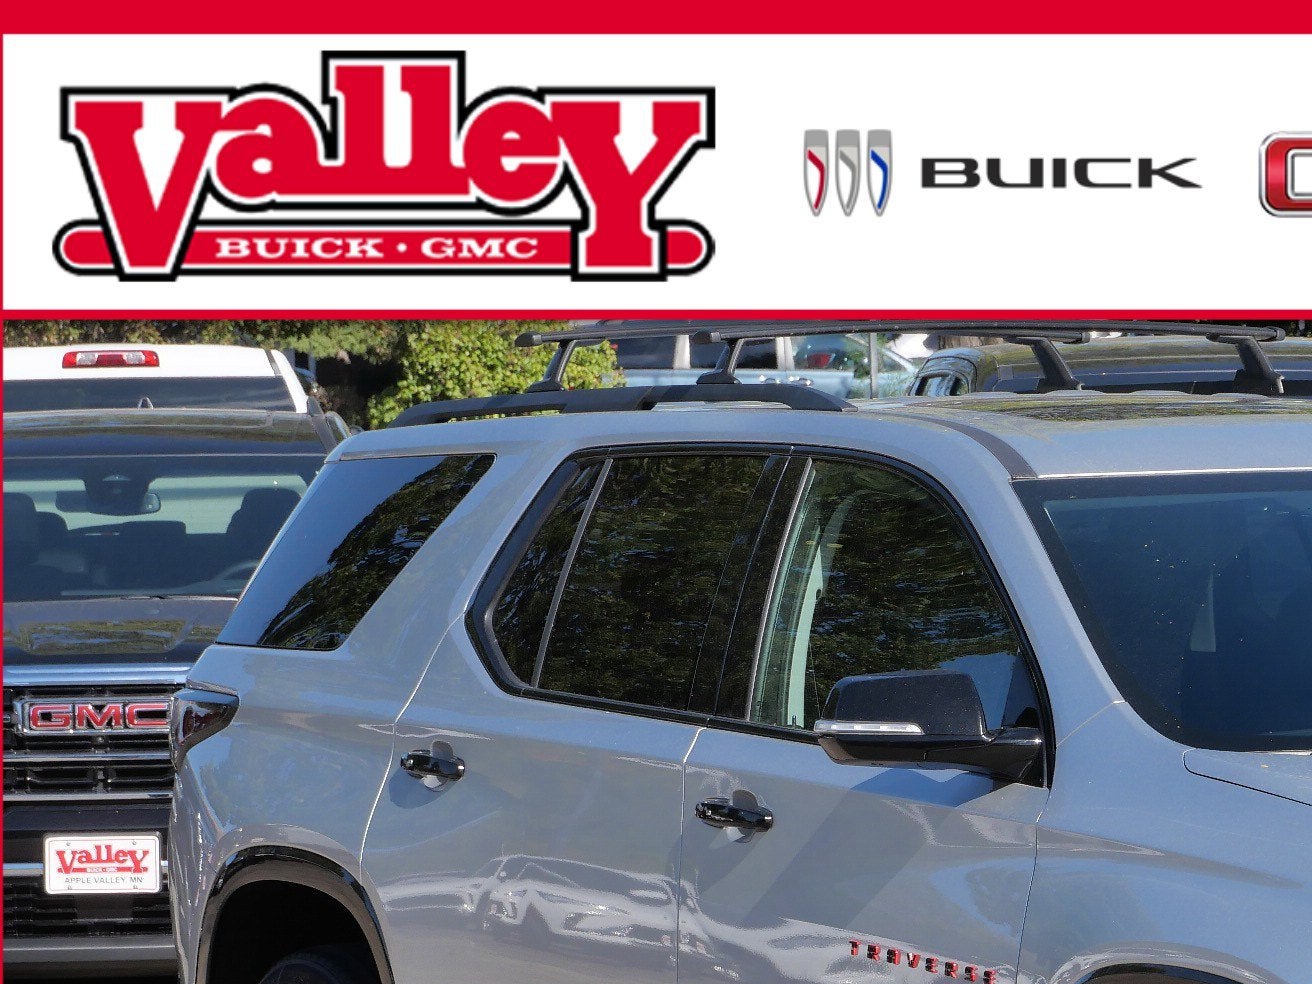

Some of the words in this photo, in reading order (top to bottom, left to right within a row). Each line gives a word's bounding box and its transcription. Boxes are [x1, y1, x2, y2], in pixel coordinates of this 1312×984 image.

[29, 702, 170, 730] GMC
[56, 844, 150, 875] Valley
[65, 876, 91, 884] APPLE
